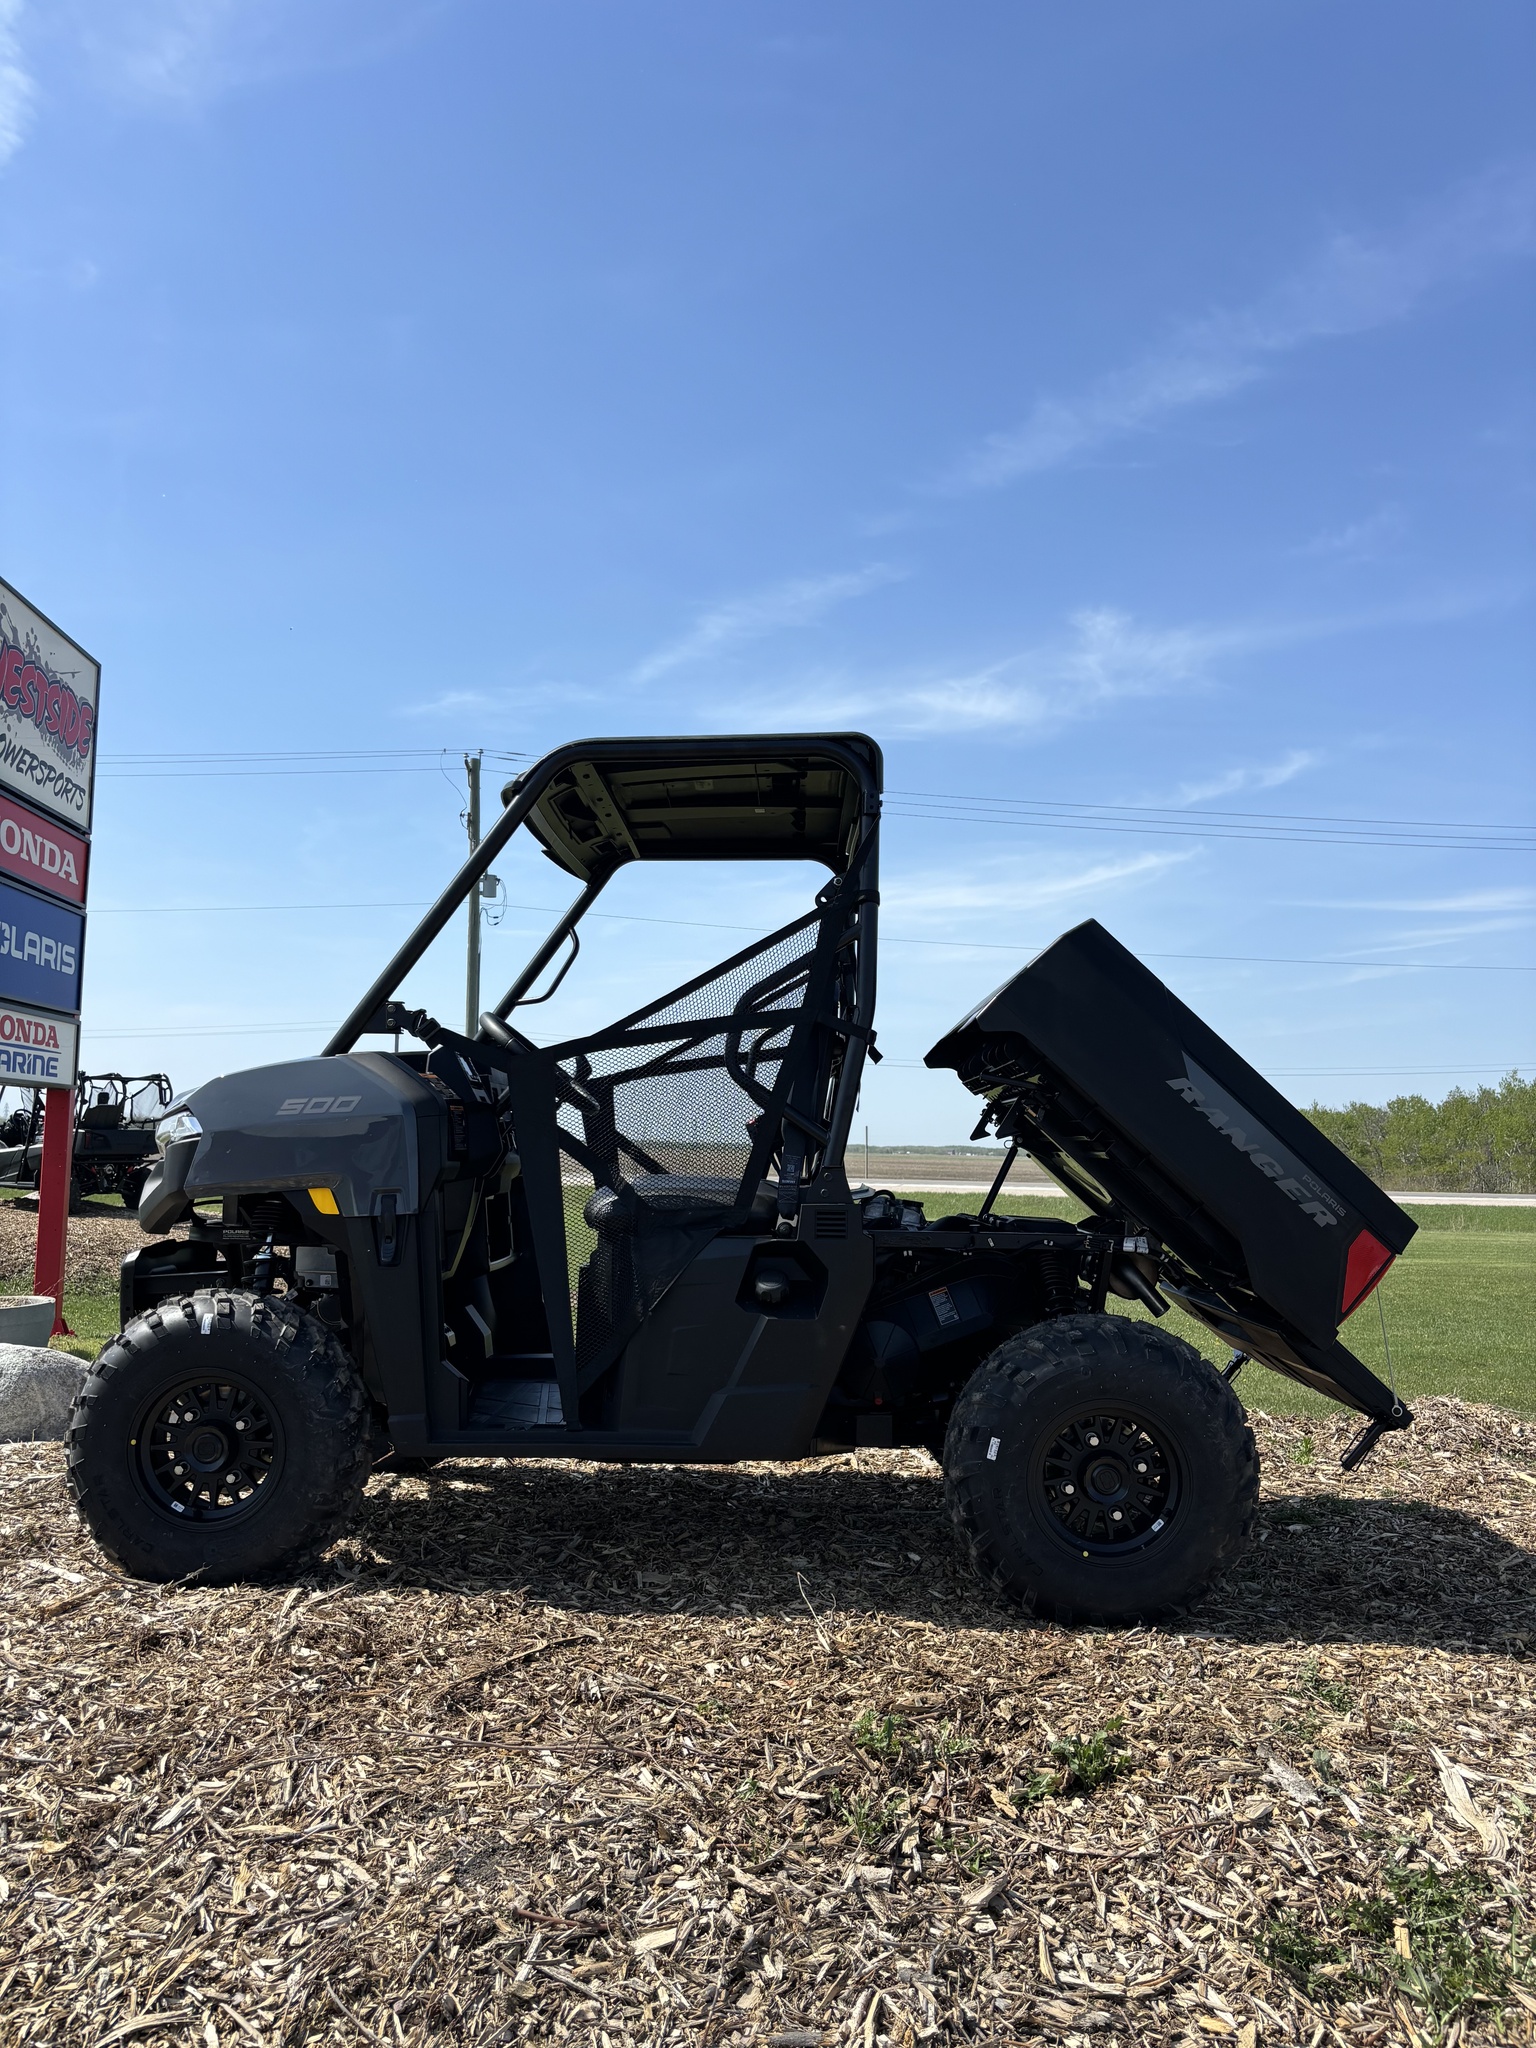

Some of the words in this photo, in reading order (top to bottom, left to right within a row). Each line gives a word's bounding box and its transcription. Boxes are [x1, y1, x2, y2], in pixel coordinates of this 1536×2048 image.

[0, 817, 79, 885] ONDA
[0, 1014, 60, 1049] ONDA
[275, 1095, 362, 1116] 500
[1165, 1077, 1338, 1228] RANGER
[1302, 1174, 1347, 1217] POLARIS
[992, 1487, 1044, 1577] CARLSTAR
